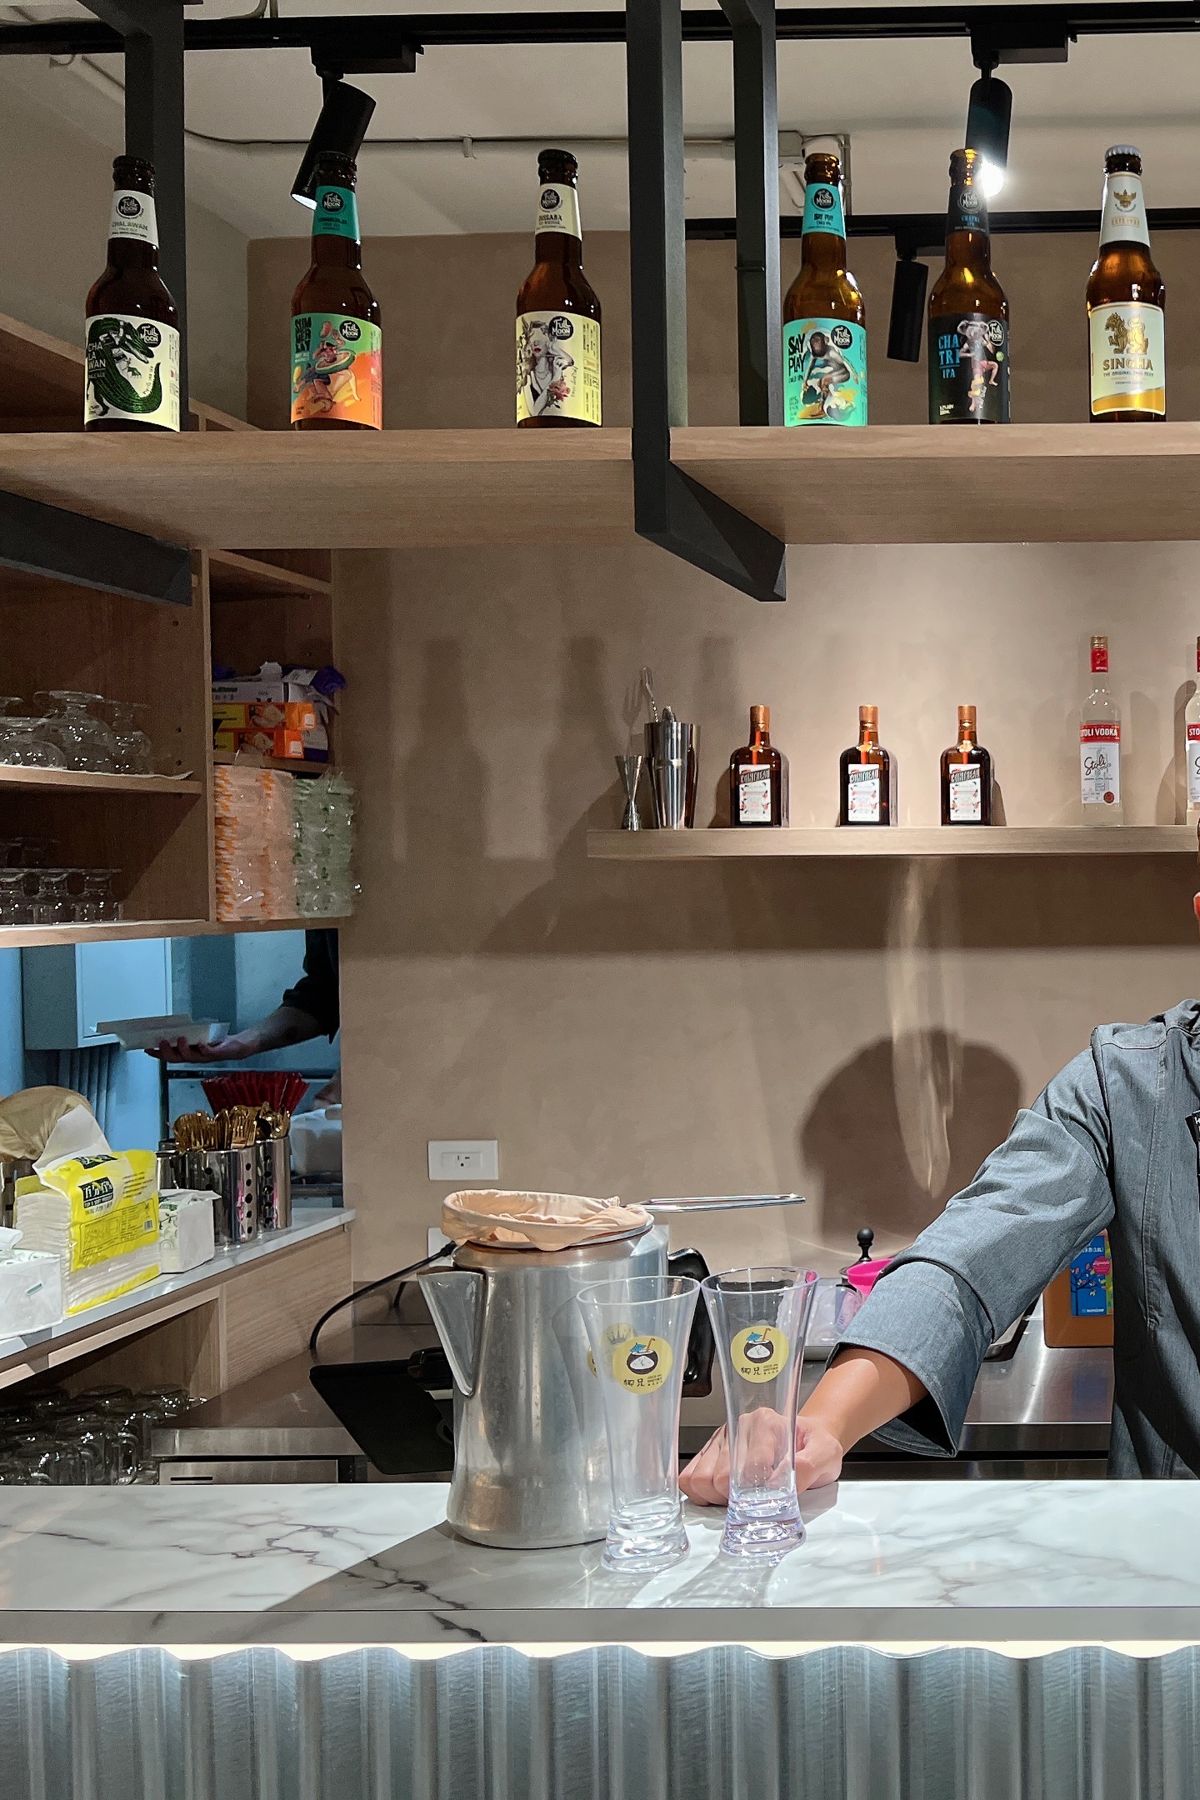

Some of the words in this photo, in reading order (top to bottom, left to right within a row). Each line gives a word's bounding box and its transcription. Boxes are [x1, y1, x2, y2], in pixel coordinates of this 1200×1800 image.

[88, 342, 103, 352] CHA
[788, 333, 806, 356] SAY
[939, 334, 959, 349] CHA
[939, 349, 960, 365] TRI
[788, 354, 805, 377] PLAY
[943, 369, 956, 379] IPA
[1095, 728, 1118, 737] VODKA
